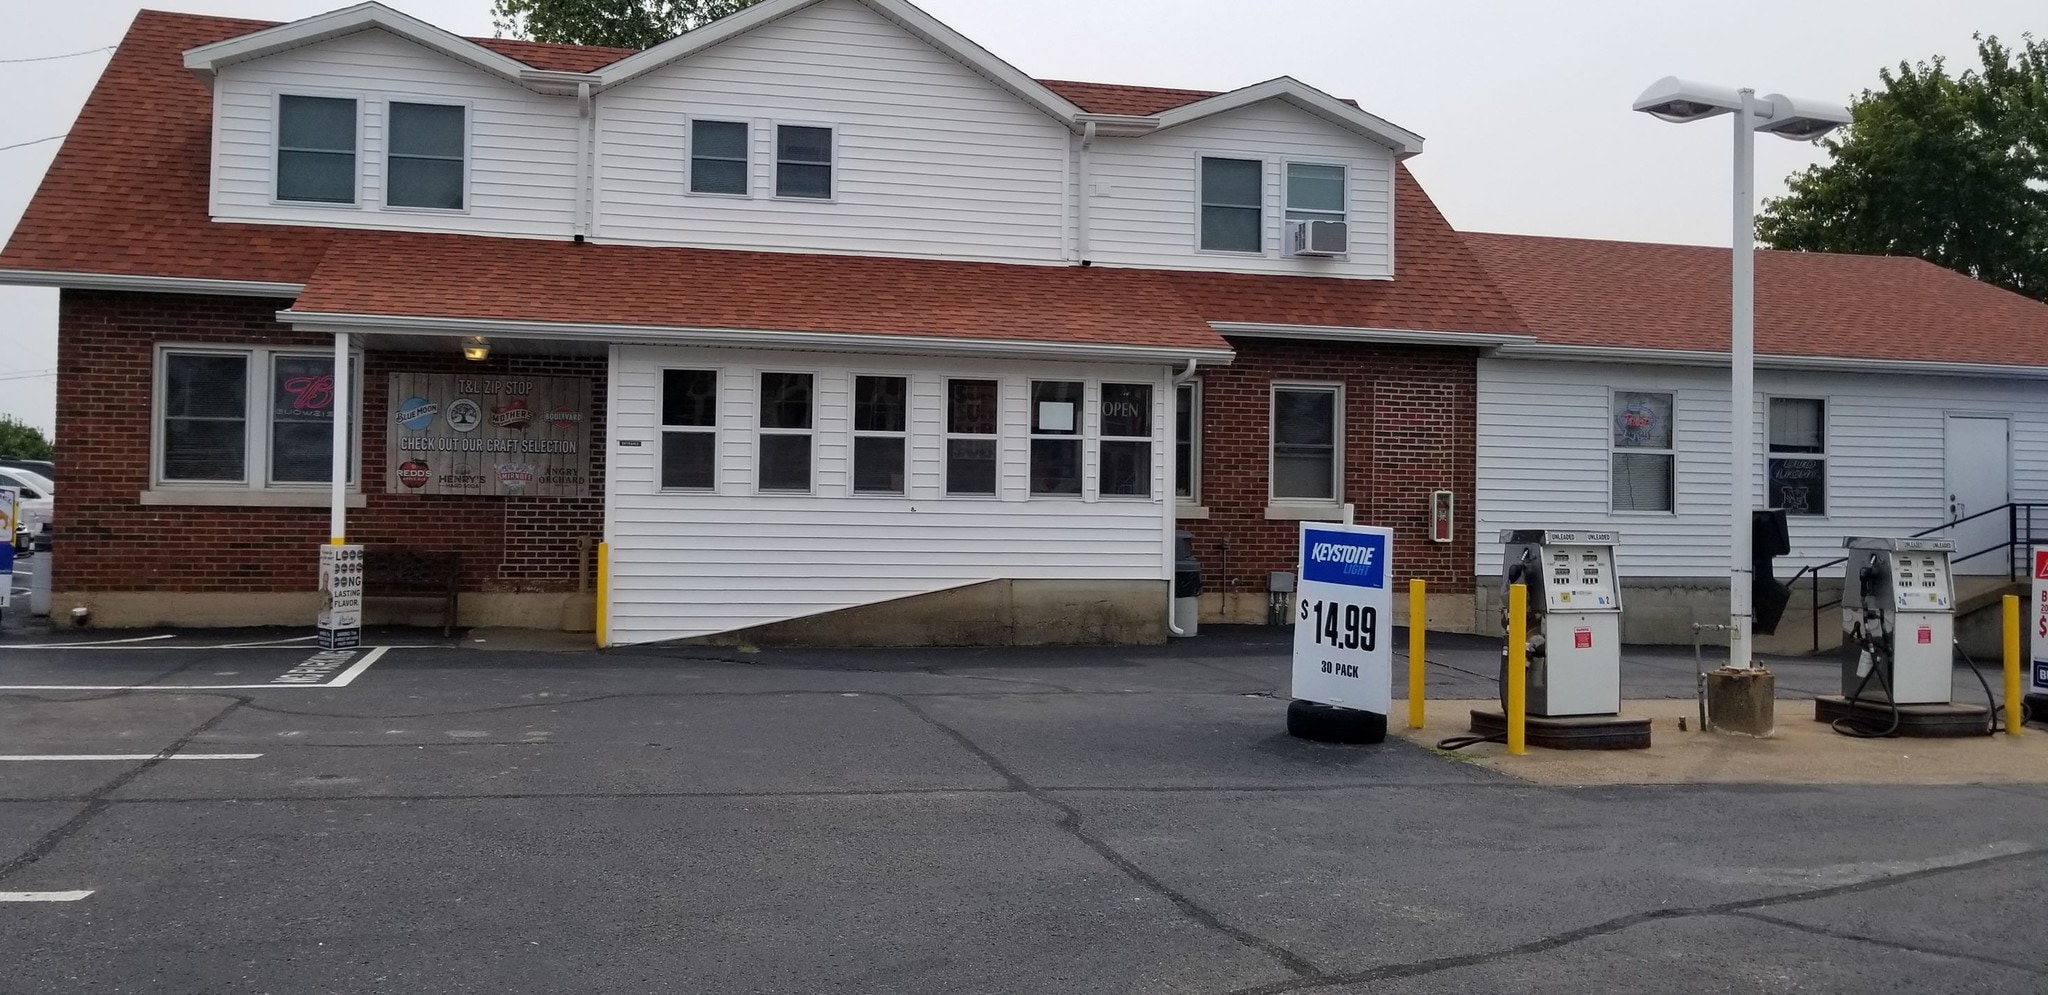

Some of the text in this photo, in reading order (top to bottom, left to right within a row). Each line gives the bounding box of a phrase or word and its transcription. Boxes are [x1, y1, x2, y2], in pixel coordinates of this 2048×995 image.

[458, 379, 533, 395] T&L ZIP STOP
[395, 404, 437, 423] BLUE MOON
[1102, 401, 1139, 418] OPEN
[545, 412, 582, 421] BOULEVARD
[401, 437, 577, 454] CHECK OUT OUR CRAFT SELECTION
[544, 467, 578, 476] ANGRY
[438, 474, 487, 484] HENRY'S
[538, 476, 585, 485] ORCHARD
[1551, 533, 1575, 541] UNLEADED
[1587, 533, 1610, 541] UNLEADED
[1311, 542, 1376, 565] KEYSTONE
[1343, 563, 1371, 576] LIGHT
[334, 589, 360, 598] LASTING
[334, 599, 359, 608] FLAVOR.
[1321, 660, 1359, 679] 30 PACK
